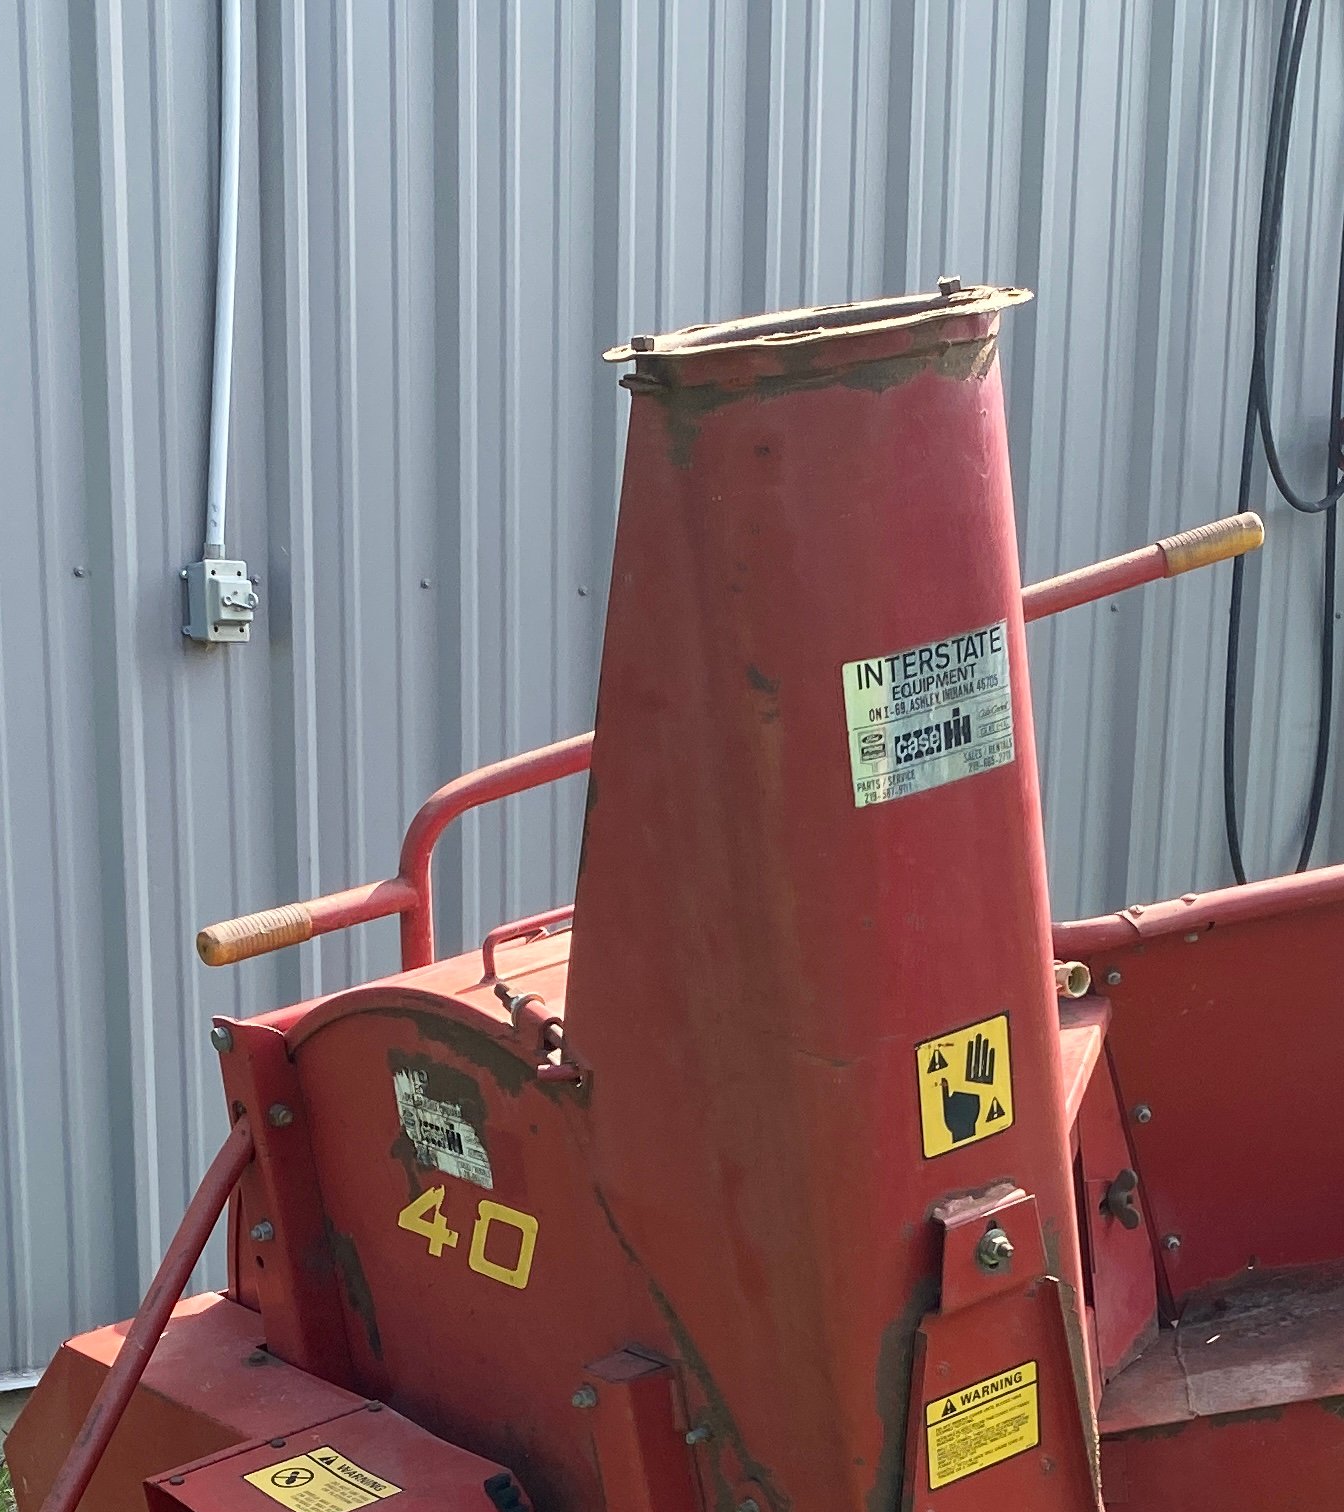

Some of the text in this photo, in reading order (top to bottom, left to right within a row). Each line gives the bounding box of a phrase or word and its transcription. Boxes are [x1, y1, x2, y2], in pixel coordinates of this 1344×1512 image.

[856, 626, 1002, 690] INTERSTATE
[868, 706, 882, 723] ON
[942, 682, 975, 702] INDIANA
[976, 675, 999, 692] 46705
[892, 662, 977, 701] EQUIPMENT
[857, 778, 881, 793] PARTS
[398, 1184, 539, 1290] 40
[960, 1371, 1023, 1407] WARNING
[337, 1463, 387, 1492] WARNING
